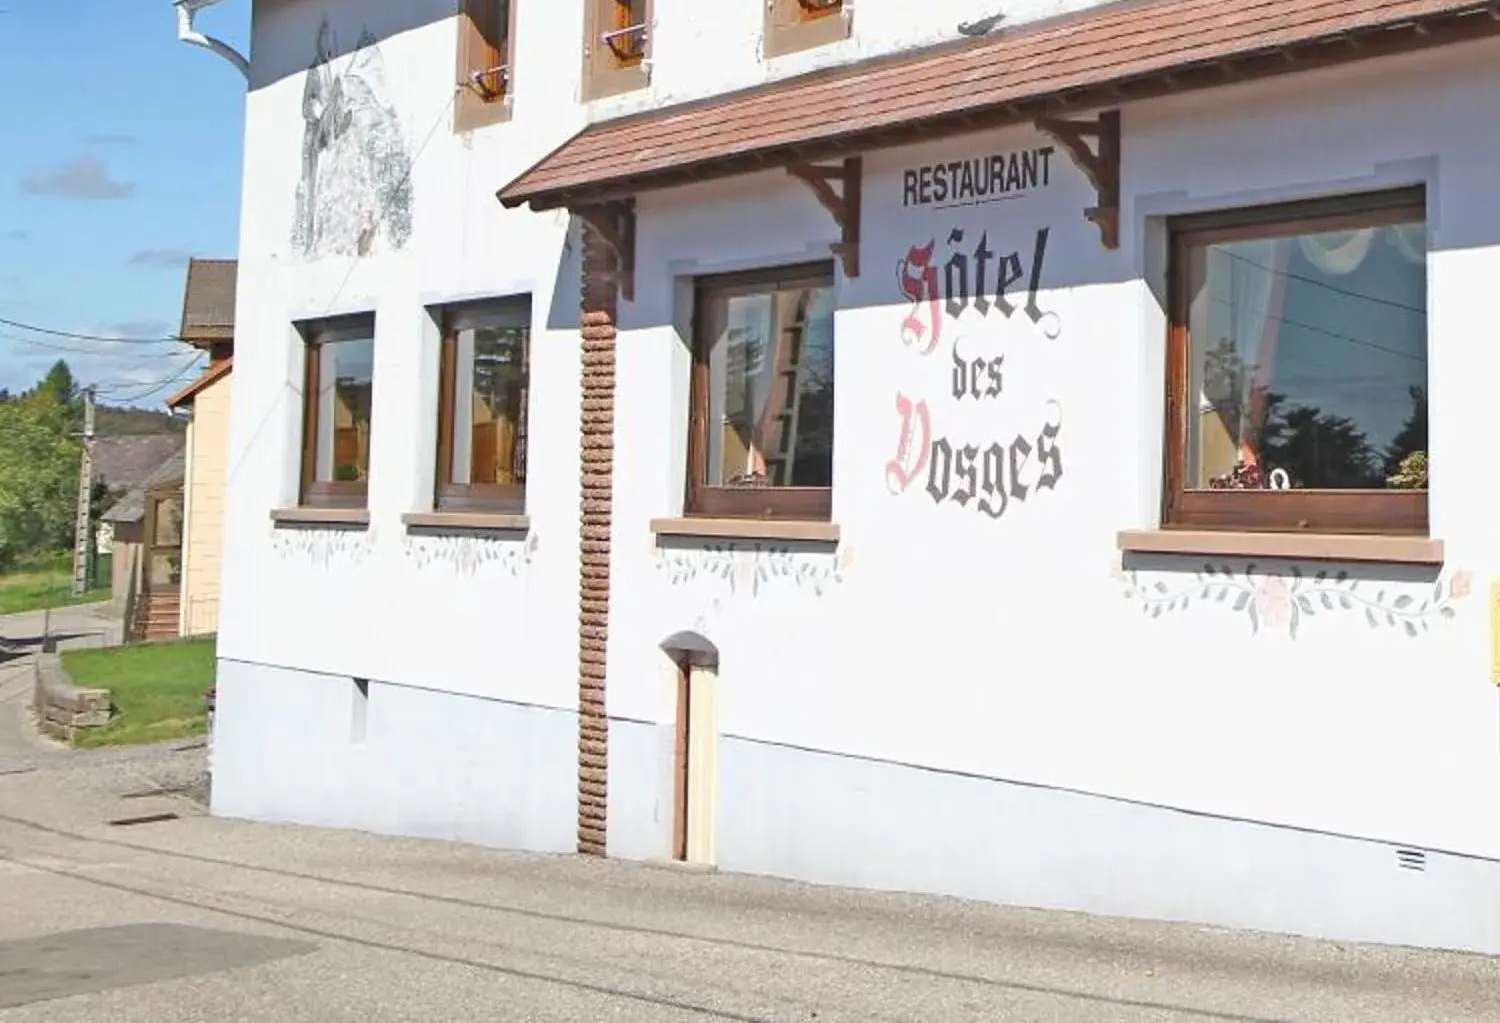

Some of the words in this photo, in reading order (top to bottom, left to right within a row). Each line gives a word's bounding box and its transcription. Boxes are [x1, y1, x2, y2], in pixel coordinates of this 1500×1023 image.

[904, 147, 1055, 206] RESTAURANT
[896, 226, 1062, 356] Hôtel
[952, 335, 1006, 400] des
[885, 390, 1064, 519] Vosges
